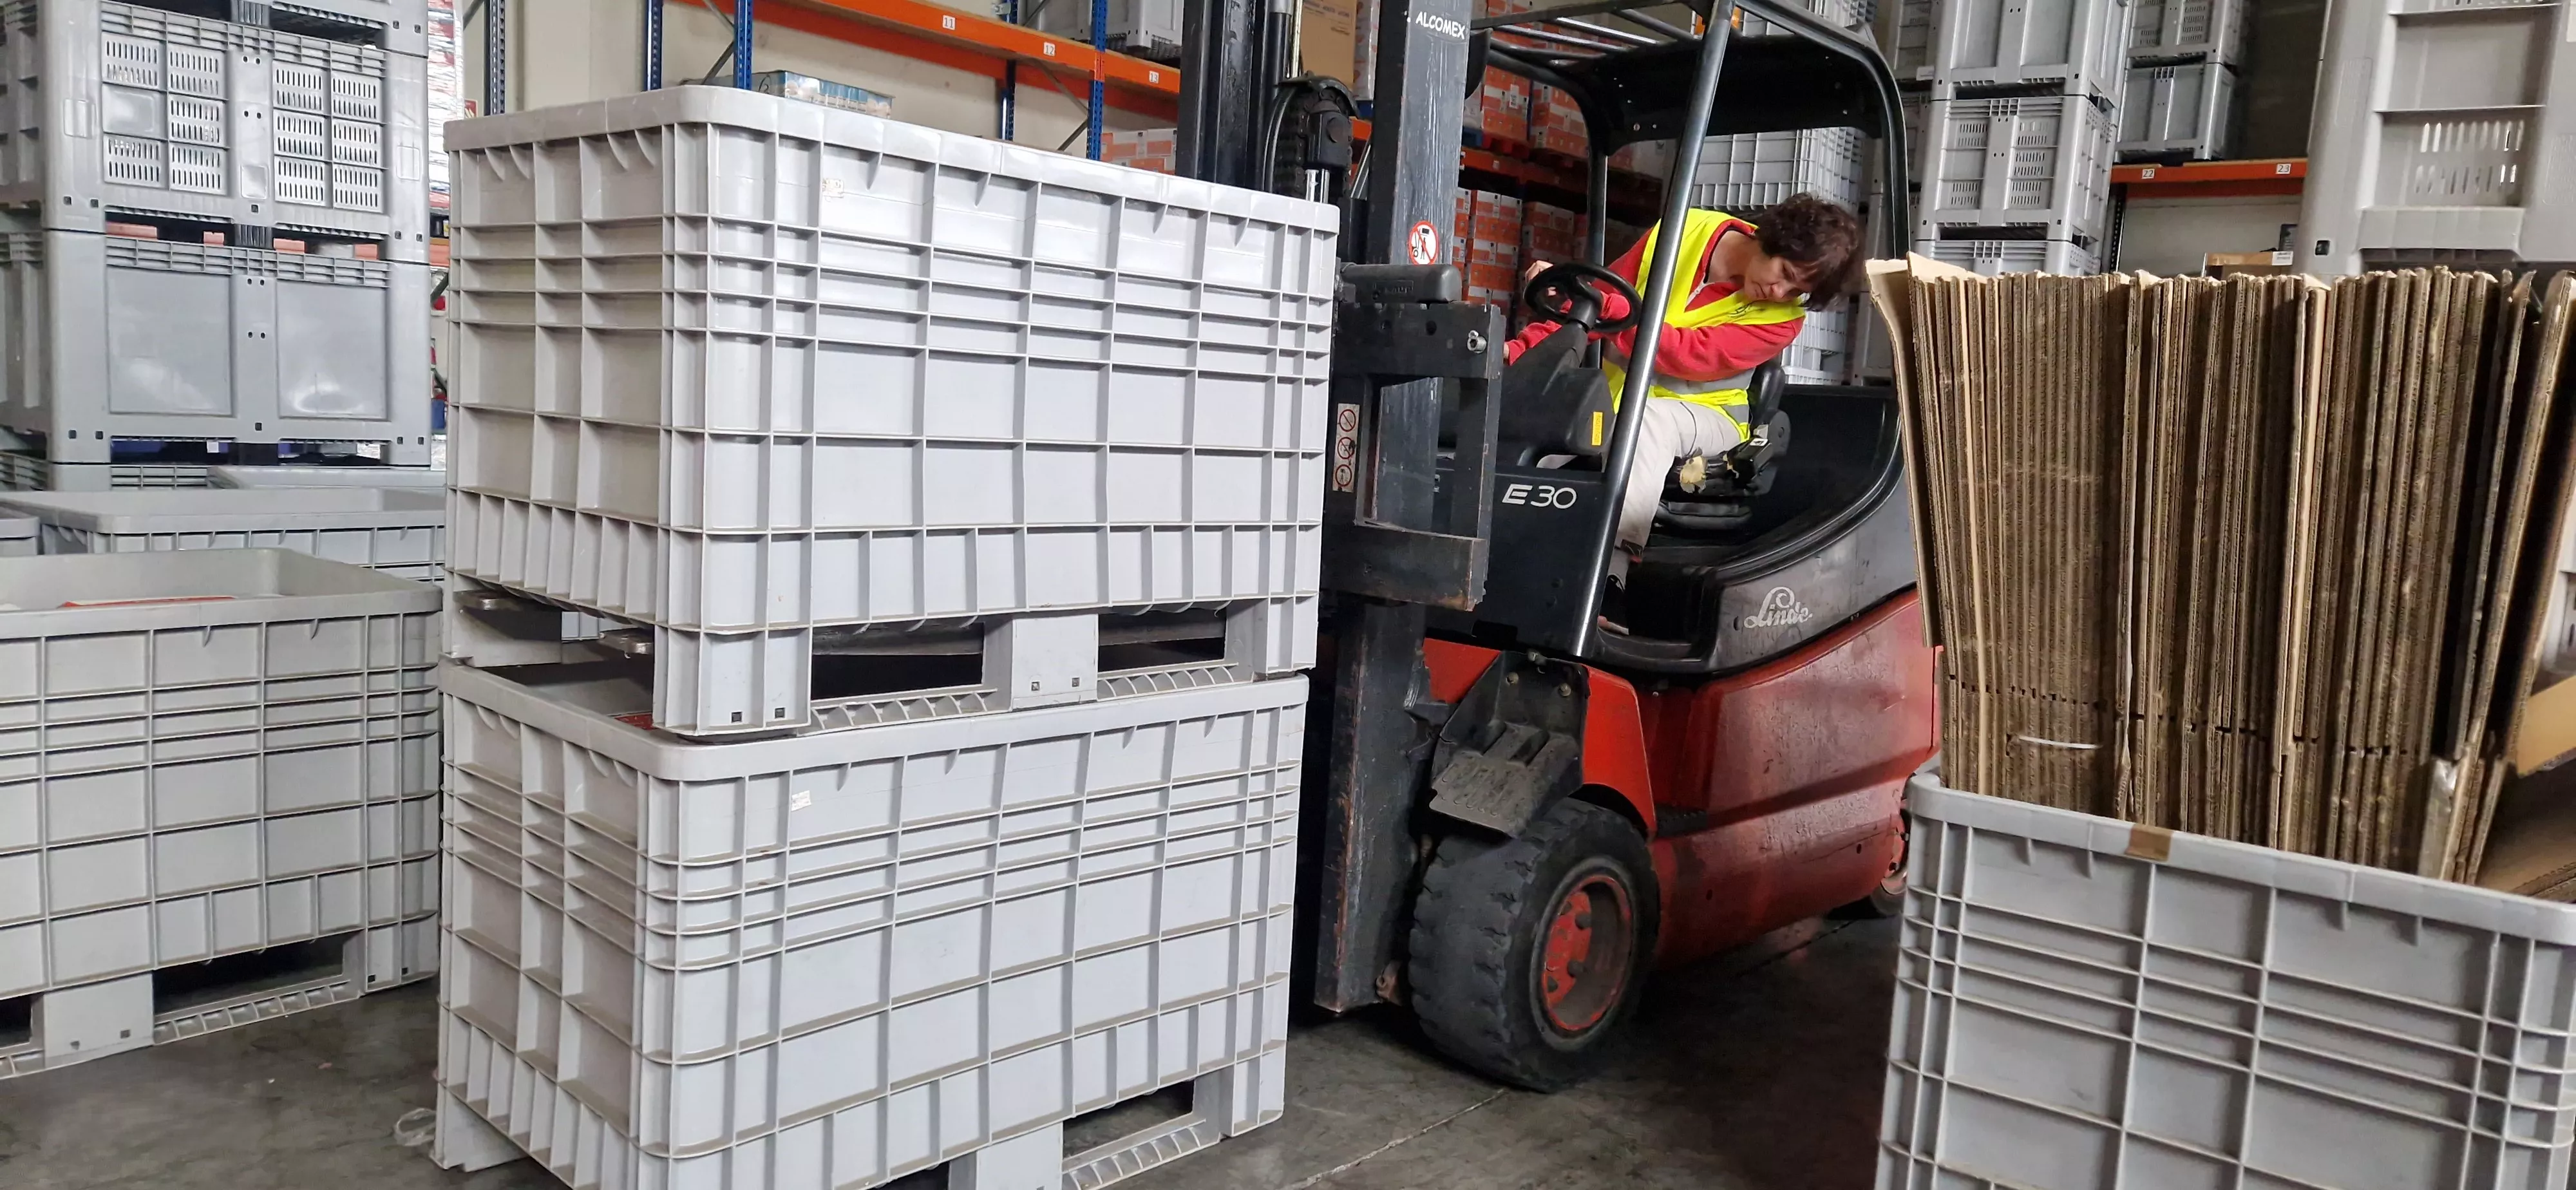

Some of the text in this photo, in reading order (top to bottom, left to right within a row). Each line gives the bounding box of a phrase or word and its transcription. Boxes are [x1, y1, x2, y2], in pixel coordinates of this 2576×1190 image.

[944, 17, 954, 28] 11
[1416, 11, 1465, 39] ALCOMEX
[1046, 45, 1054, 55] 12
[1151, 72, 1158, 82] 13
[2143, 169, 2154, 178] 22
[1744, 586, 1813, 628] Linde
